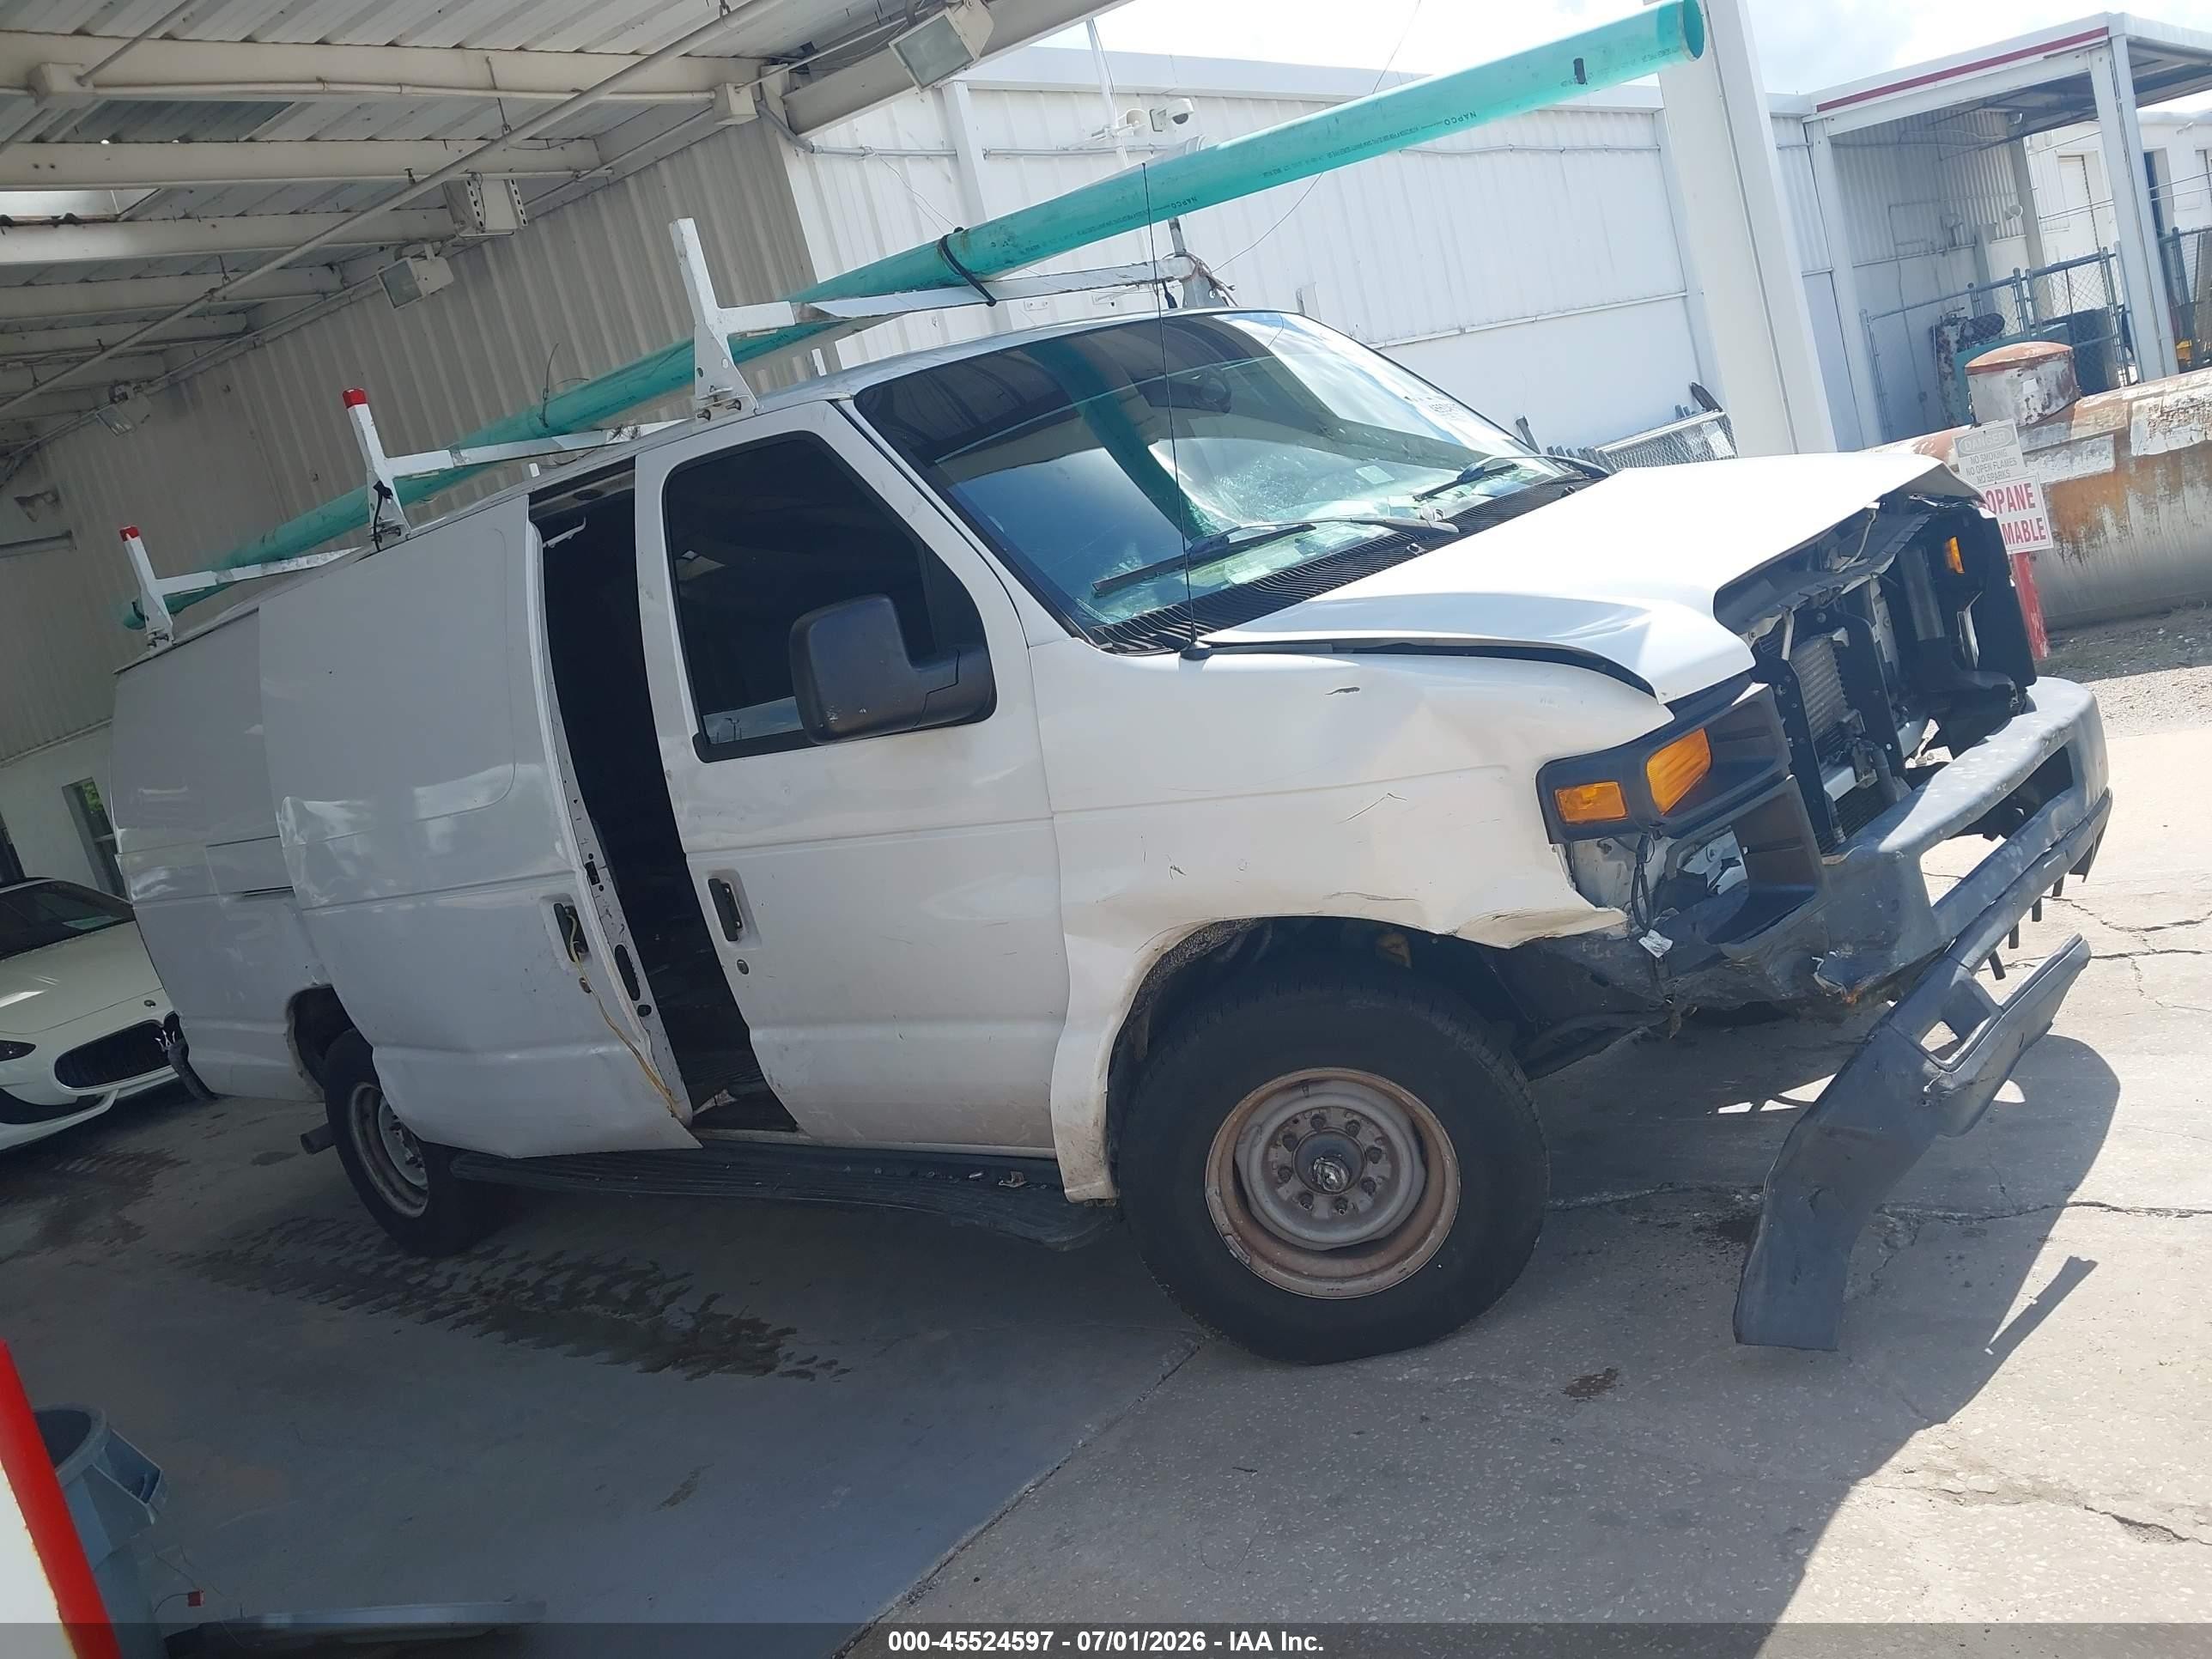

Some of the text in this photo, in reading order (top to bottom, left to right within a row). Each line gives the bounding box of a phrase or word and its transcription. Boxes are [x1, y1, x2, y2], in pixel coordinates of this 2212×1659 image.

[1443, 111, 1477, 125] NAPCO
[1964, 431, 2007, 451] DANGER
[1970, 448, 2008, 465] NO SMOKING
[1966, 459, 2018, 477] NO OPEN FLAMES
[1978, 469, 2011, 484] NO SPARKS
[1984, 483, 2036, 515] OPANE
[2001, 517, 2047, 545] MABLE
